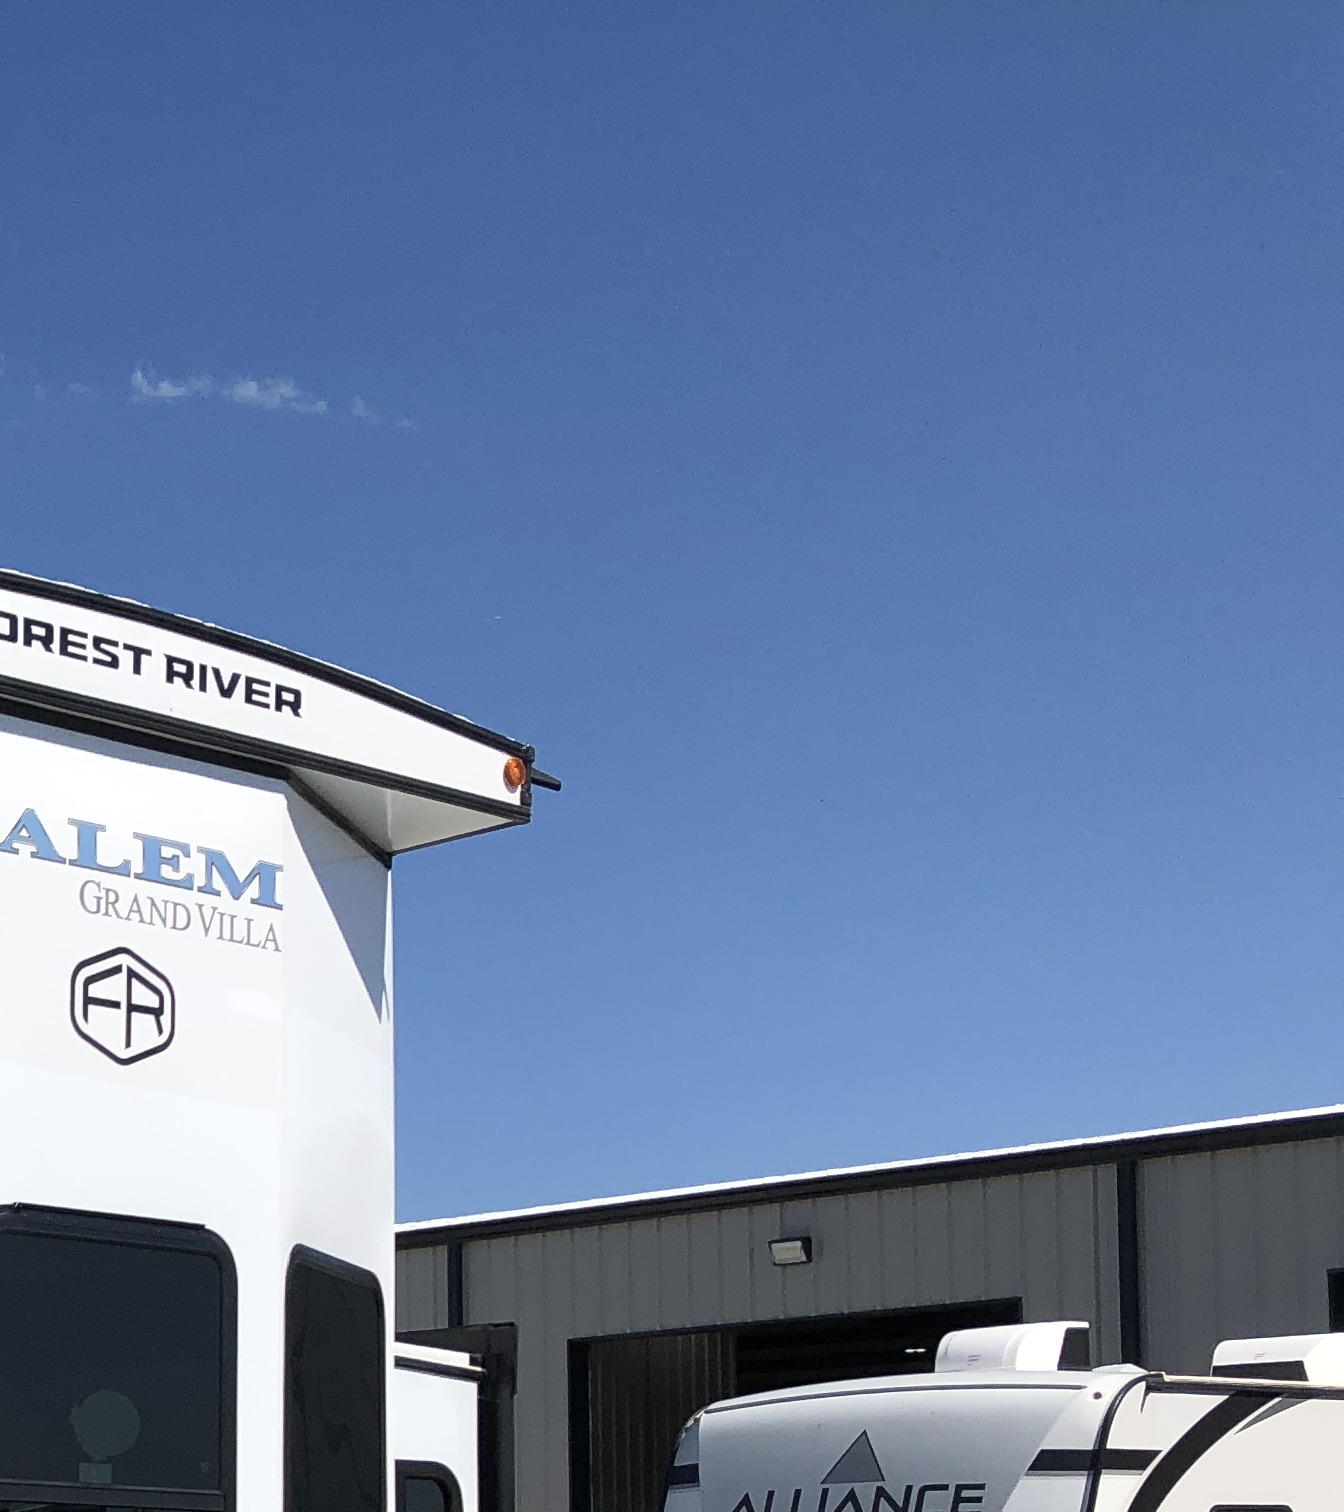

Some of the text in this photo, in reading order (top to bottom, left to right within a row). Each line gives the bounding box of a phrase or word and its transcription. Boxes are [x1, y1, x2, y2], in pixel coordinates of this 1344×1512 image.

[163, 653, 303, 718] RIVER
[78, 879, 282, 953] GRAND VILLA
[82, 963, 164, 1050] FR
